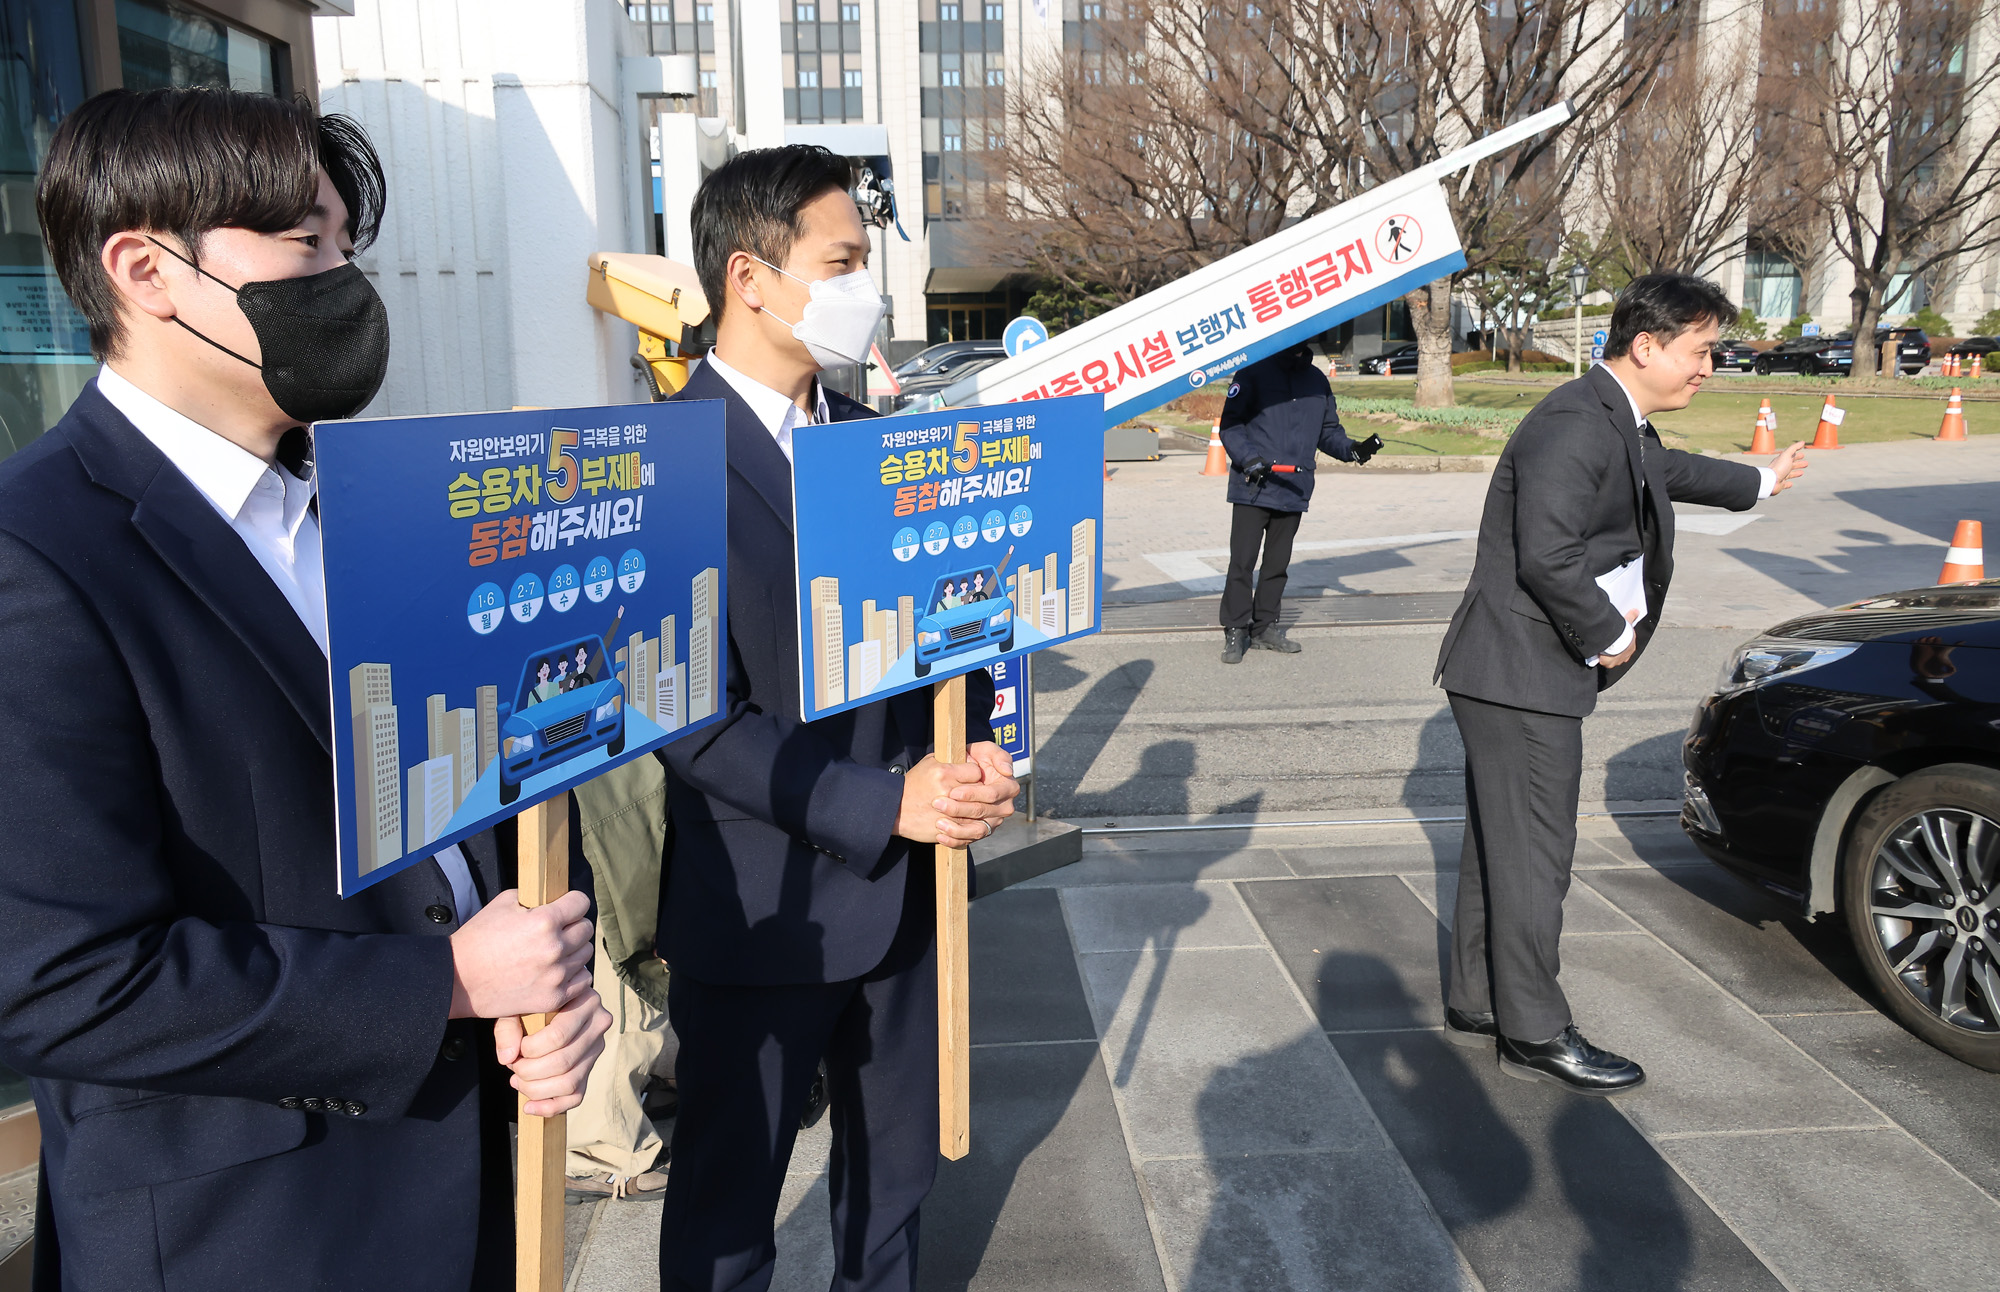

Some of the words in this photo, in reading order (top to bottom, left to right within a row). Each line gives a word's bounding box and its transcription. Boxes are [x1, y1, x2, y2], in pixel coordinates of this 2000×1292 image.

[1175, 303, 1247, 356] 보행자
[1246, 238, 1373, 323] 통행금지
[450, 433, 545, 462] 자원안보위기
[582, 426, 620, 448] 극복을
[623, 424, 647, 444] 위한
[881, 425, 952, 449] 자원안보위기
[983, 417, 1013, 435] 극복을
[1016, 414, 1036, 430] 위한
[880, 447, 949, 486] 승용차
[448, 464, 543, 519] 승용차
[902, 547, 910, 559] 월
[932, 541, 940, 552] 화
[961, 536, 969, 545] 수
[990, 529, 997, 539] 목
[1017, 524, 1024, 534] 금
[481, 613, 491, 630] 월
[522, 603, 532, 617] 화
[560, 593, 569, 607] 수
[595, 584, 603, 597] 목
[628, 575, 636, 590] 금
